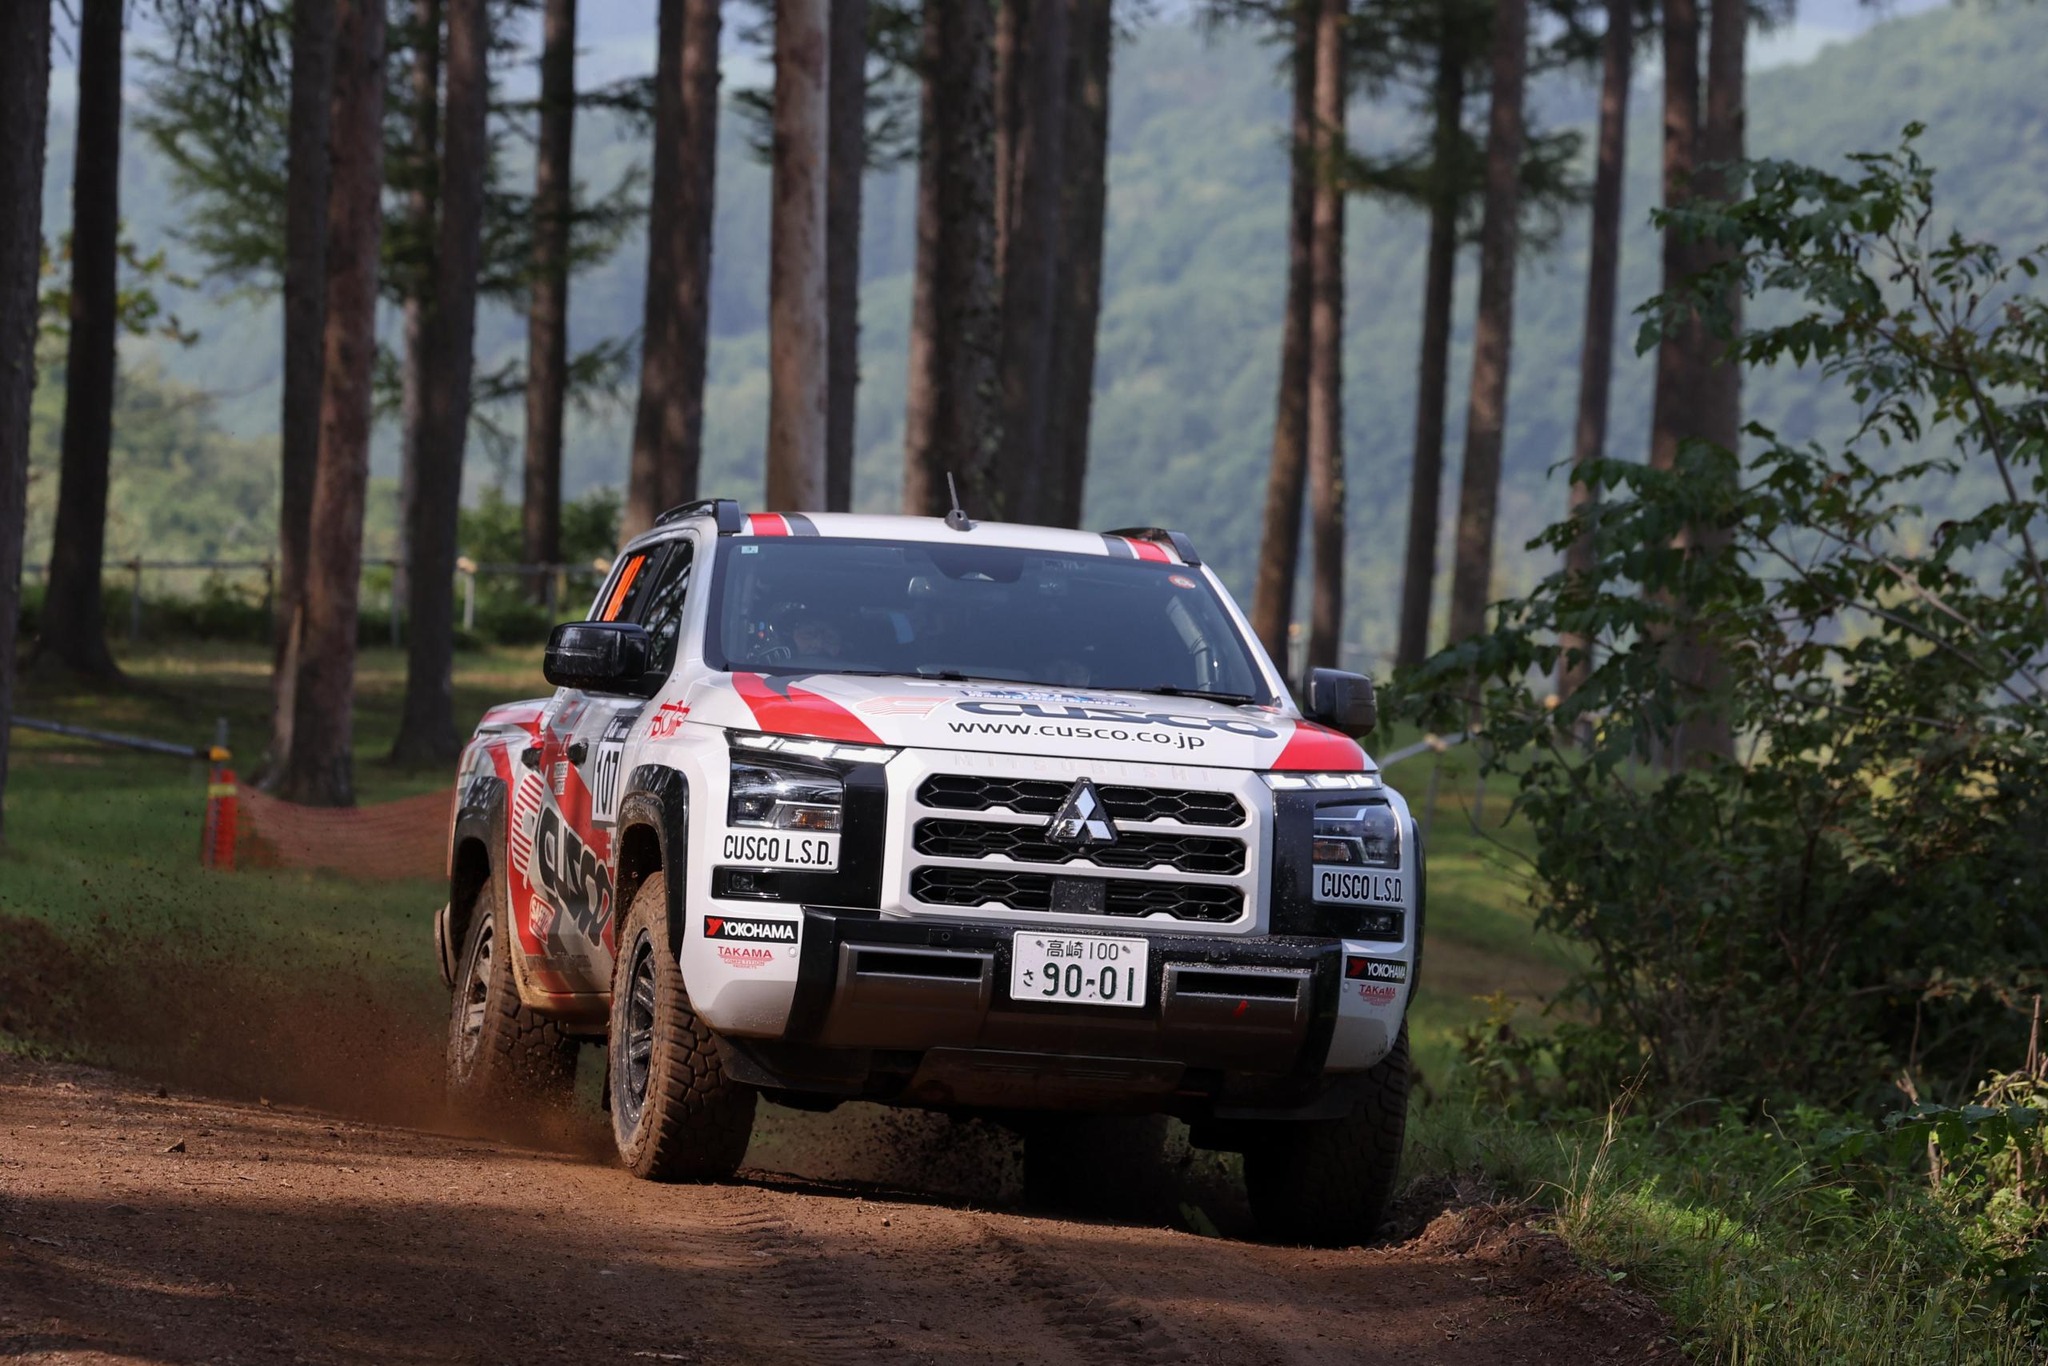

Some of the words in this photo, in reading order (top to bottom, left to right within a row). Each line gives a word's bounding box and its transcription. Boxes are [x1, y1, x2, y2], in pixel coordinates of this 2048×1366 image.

[947, 722, 1205, 750] www.cusco.co.jp
[954, 755, 1213, 781] MITSUBISHI
[595, 750, 621, 815] 107
[723, 834, 780, 862] CUSCO
[785, 838, 833, 866] L.S.D.
[1321, 872, 1370, 900] CUSCO
[1373, 876, 1404, 903] L.S.D.
[722, 921, 795, 940] YOKOHAMA
[717, 945, 773, 958] TAKAMA
[1022, 969, 1034, 987] さ
[1367, 962, 1406, 979] YOKOHAMA
